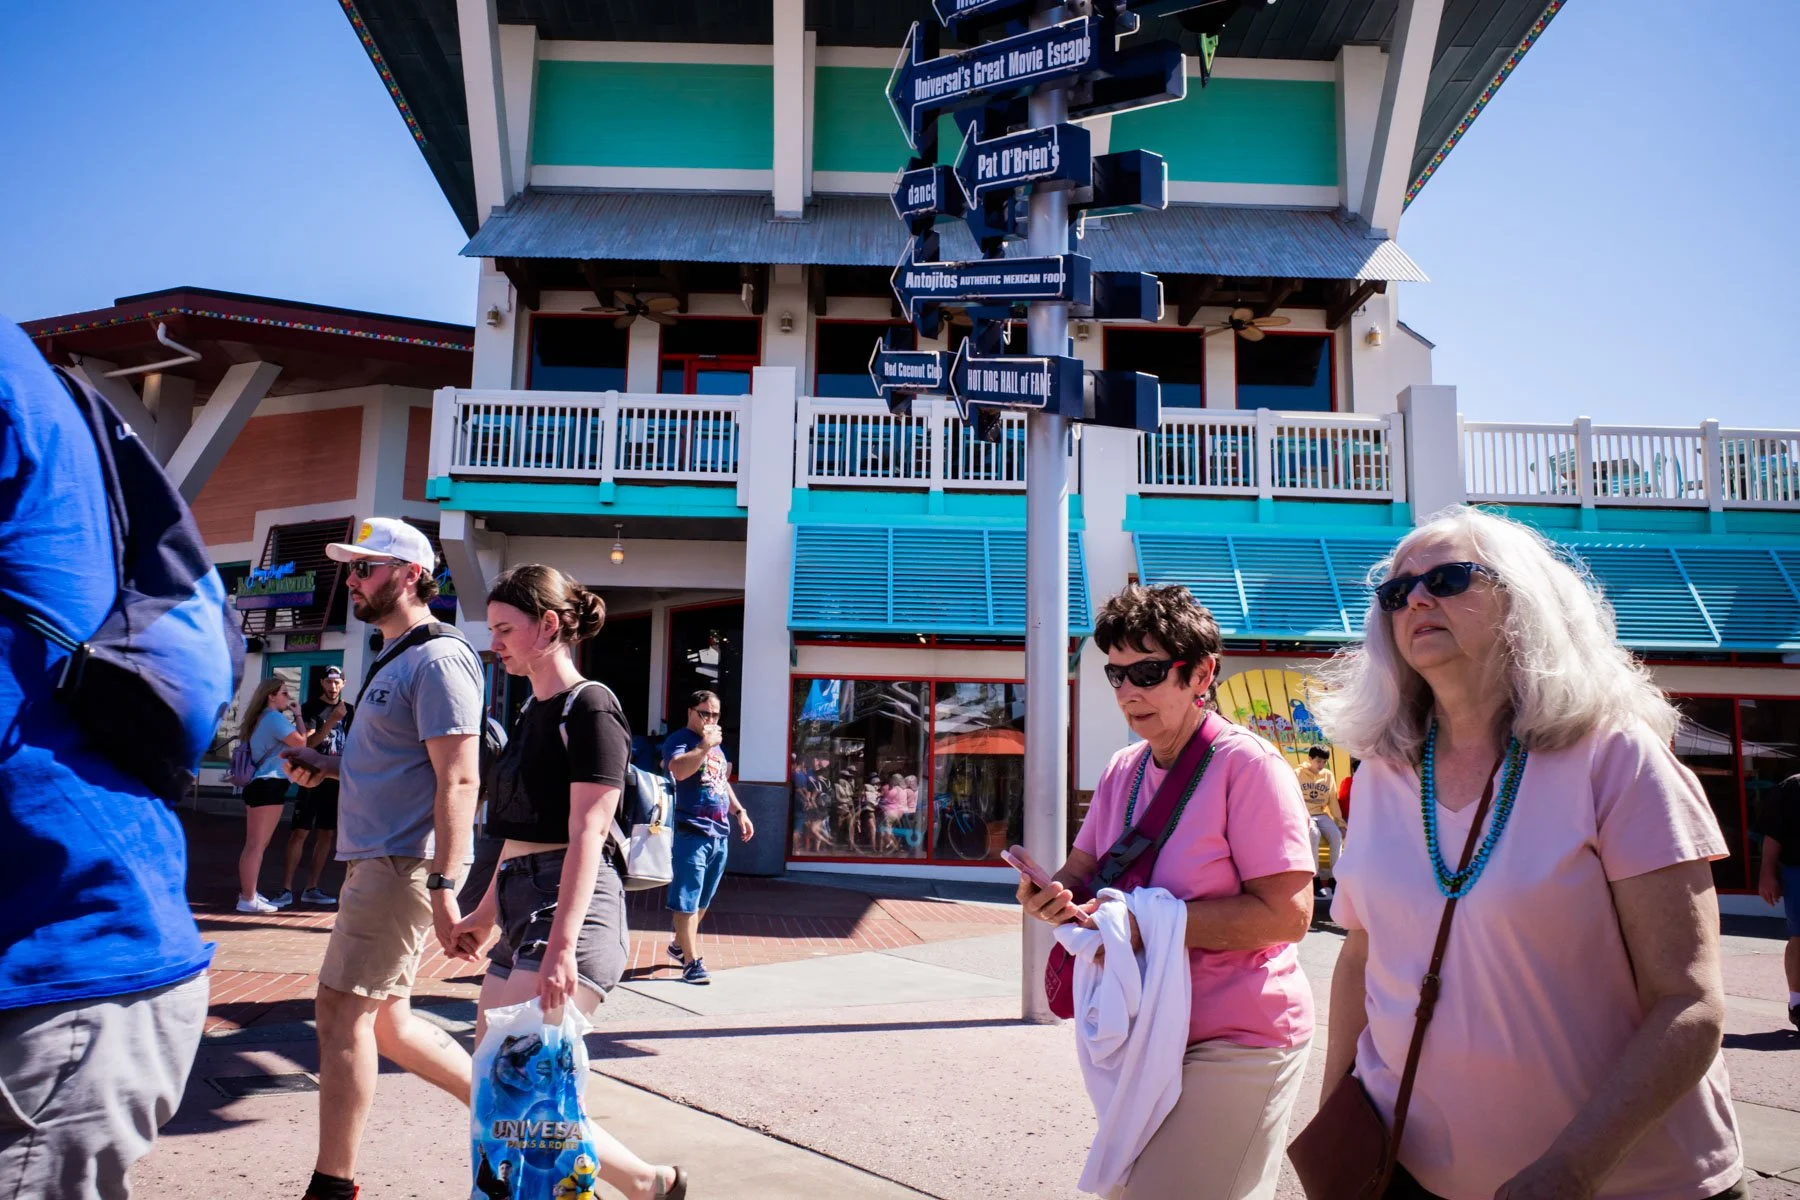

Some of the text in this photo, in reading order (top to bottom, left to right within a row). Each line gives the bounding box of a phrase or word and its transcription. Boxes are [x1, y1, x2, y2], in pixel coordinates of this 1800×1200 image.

[915, 35, 1091, 100] Universal's Great Movie Escape
[977, 141, 1060, 180] Pat O'Brien's
[908, 183, 937, 206] dance
[905, 271, 1066, 291] Antojitos AUTHENTIC MEXICAN FOOD
[898, 362, 926, 379] Coconut
[967, 369, 982, 391] HOT
[983, 370, 999, 393] DOG
[1000, 371, 1019, 394] HALL
[1020, 373, 1030, 395] of
